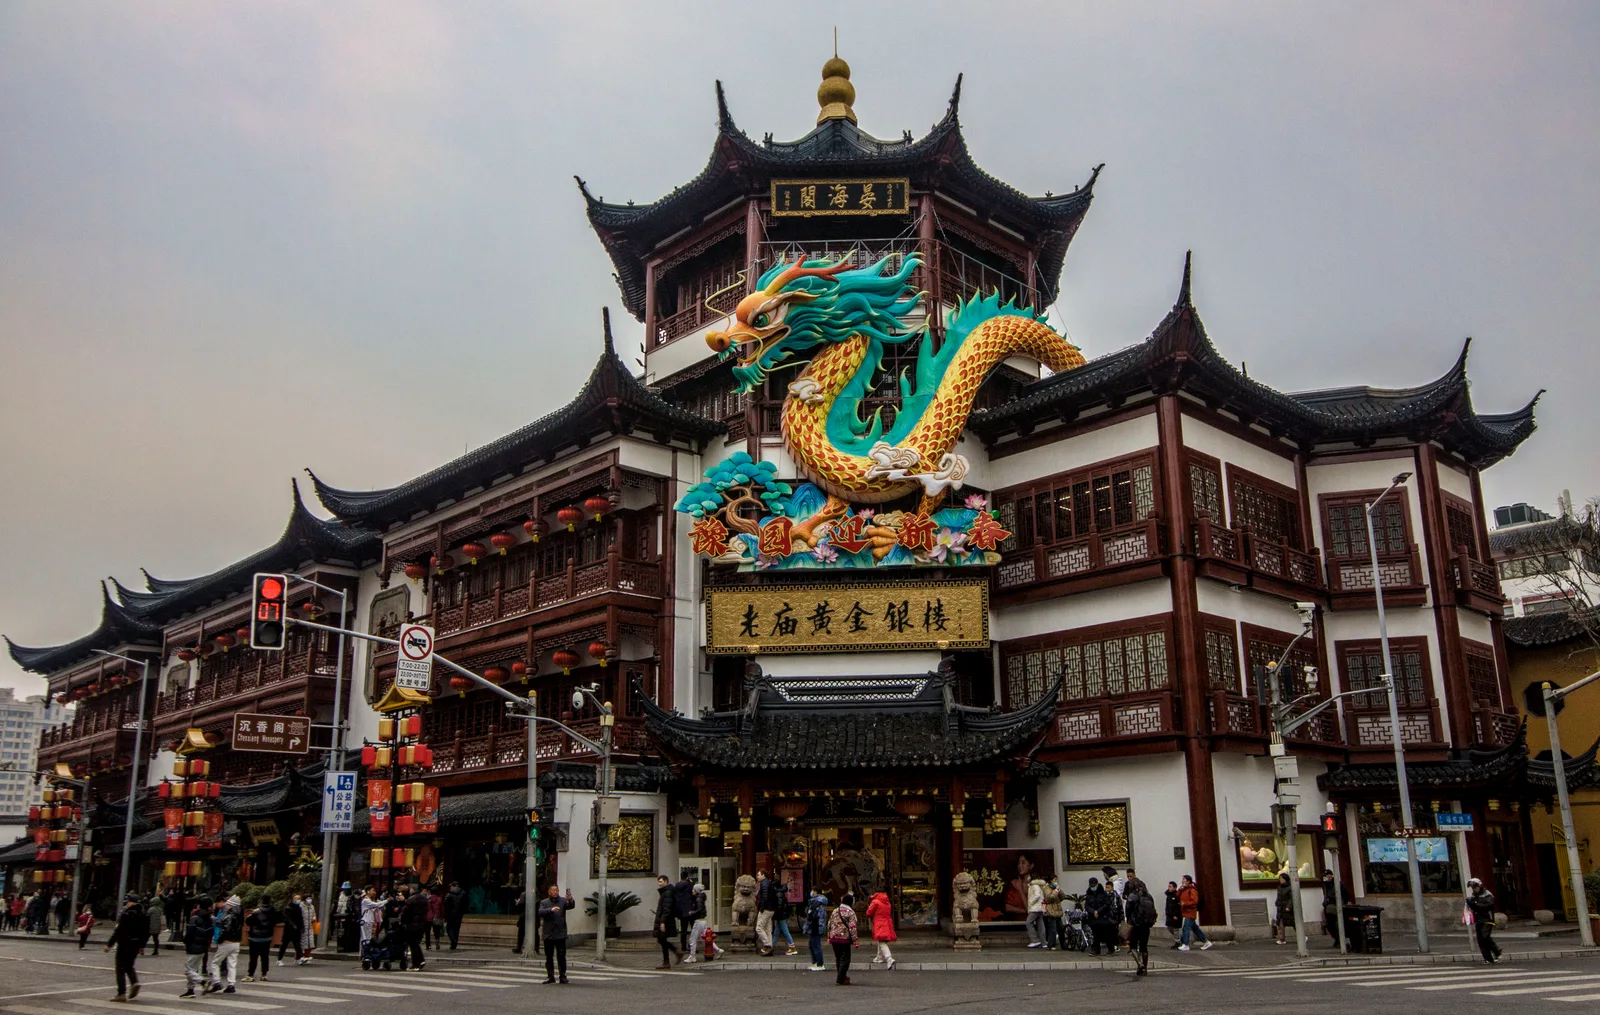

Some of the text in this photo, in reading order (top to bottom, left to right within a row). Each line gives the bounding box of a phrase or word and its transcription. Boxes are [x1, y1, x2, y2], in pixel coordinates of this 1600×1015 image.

[257, 602, 280, 621] 07
[239, 720, 284, 734] 沉香阁
